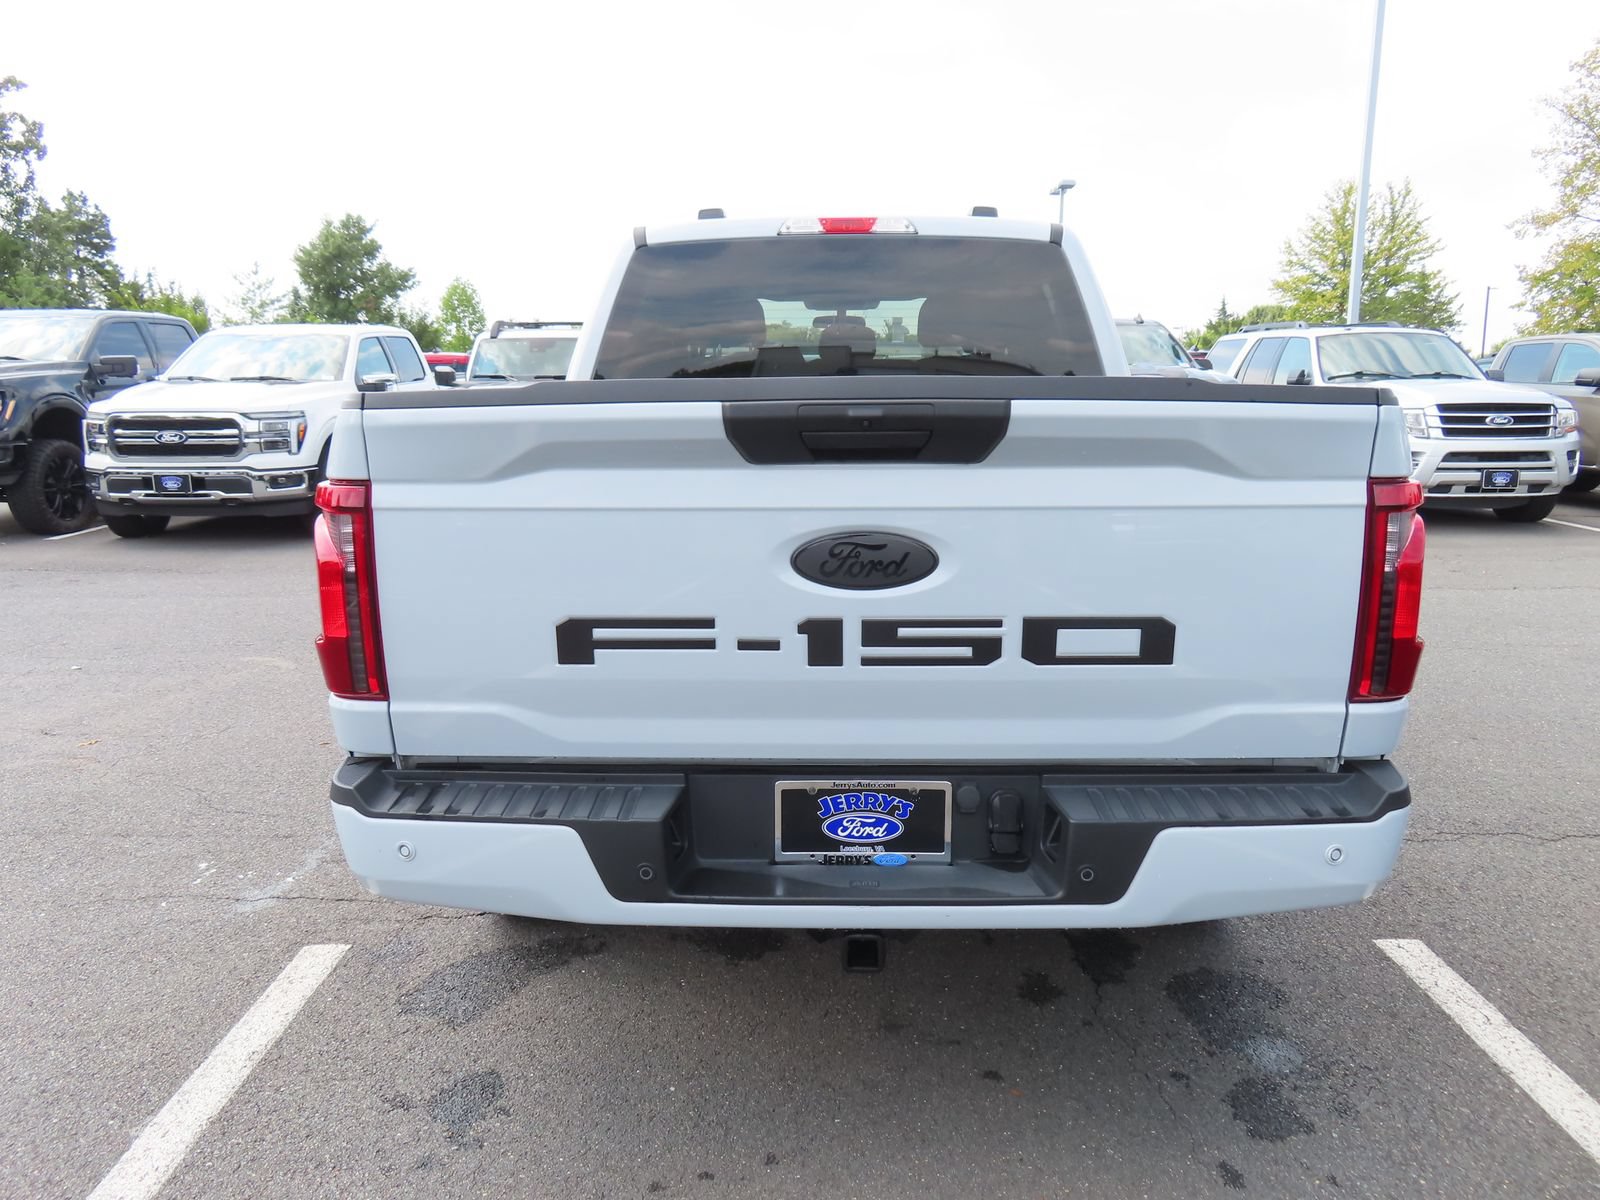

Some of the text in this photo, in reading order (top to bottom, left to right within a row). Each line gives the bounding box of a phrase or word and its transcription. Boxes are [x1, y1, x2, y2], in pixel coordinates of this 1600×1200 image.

[819, 541, 911, 578] Ford
[556, 616, 1176, 667] F-150
[830, 781, 896, 789] JerrysAuto.com
[817, 792, 914, 819] JERRY'S
[837, 817, 889, 837] Ford
[819, 854, 872, 866] JERRY'S
